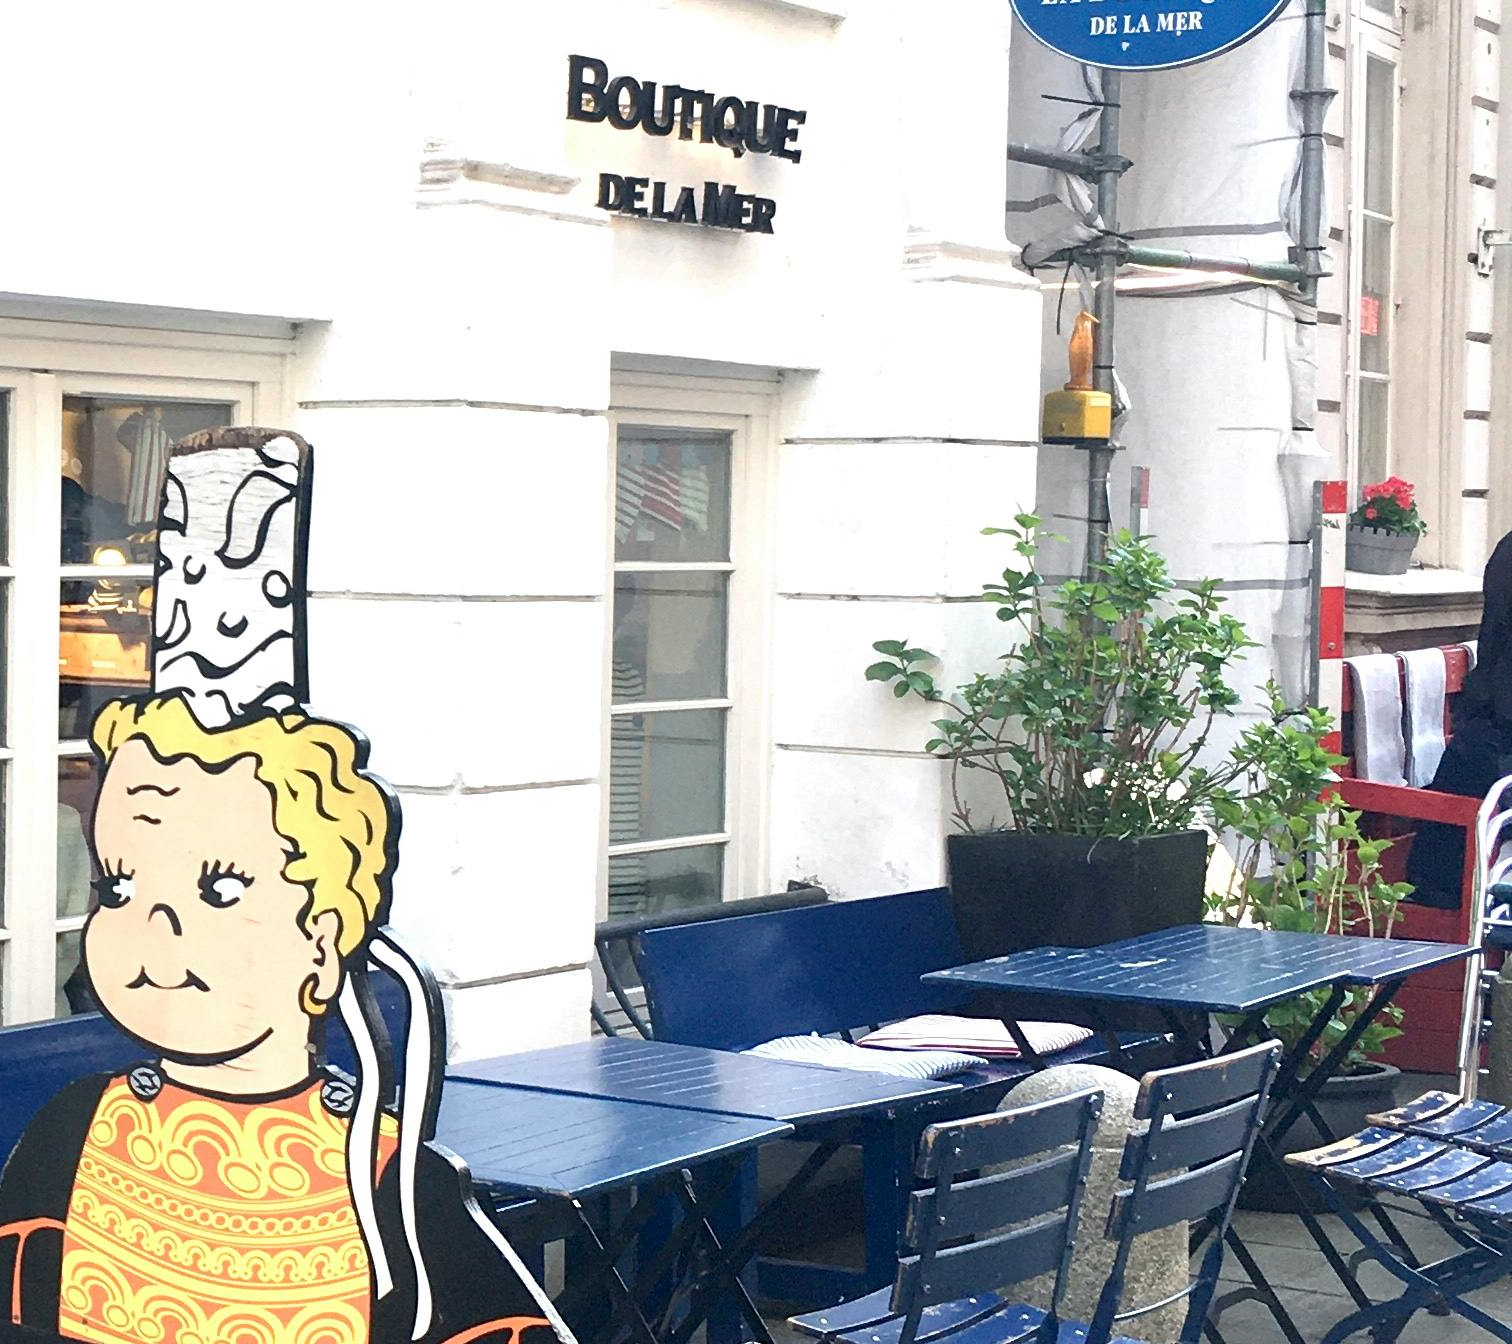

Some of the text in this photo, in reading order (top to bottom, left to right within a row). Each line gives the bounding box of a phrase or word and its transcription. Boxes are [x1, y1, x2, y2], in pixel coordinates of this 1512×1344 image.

[1090, 10, 1203, 35] DE LA MER
[595, 173, 777, 235] DE LA MER
